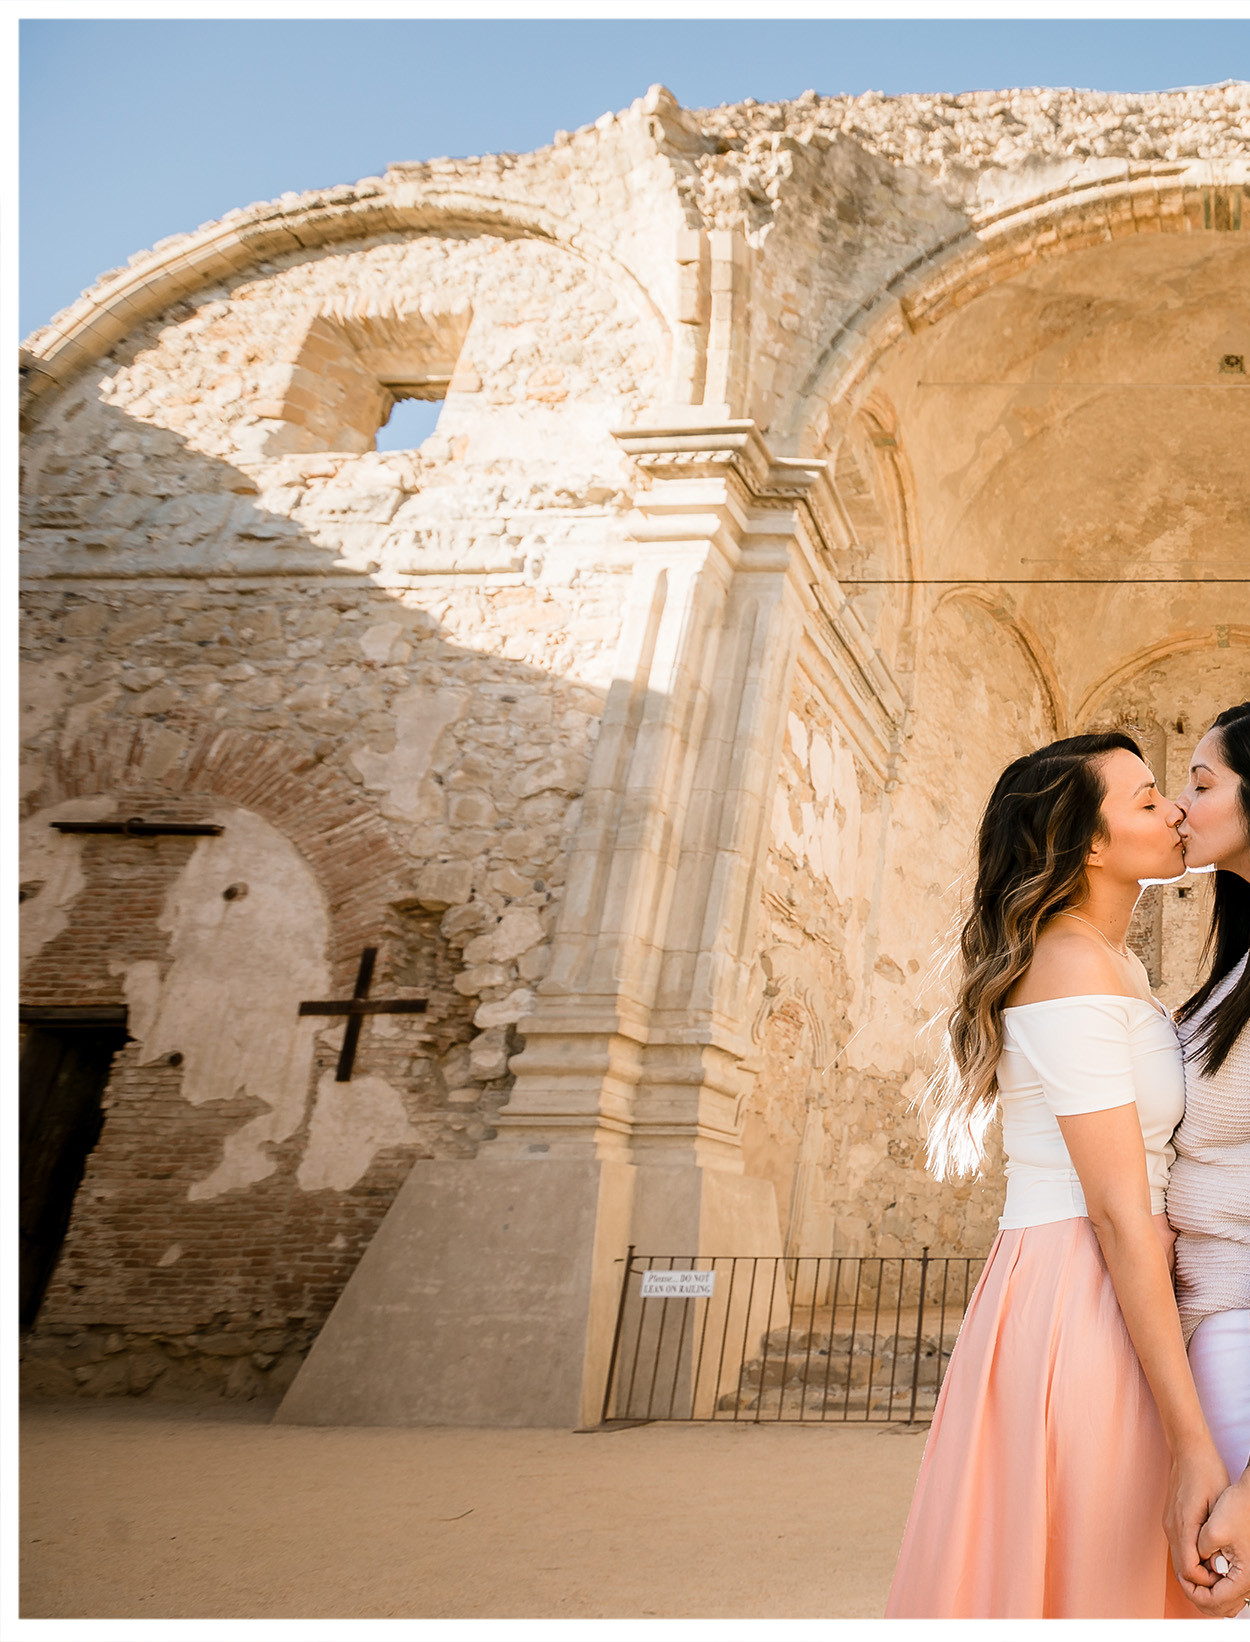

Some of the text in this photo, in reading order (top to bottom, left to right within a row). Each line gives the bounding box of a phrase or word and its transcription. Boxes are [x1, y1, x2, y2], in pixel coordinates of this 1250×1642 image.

[680, 1273, 691, 1282] DO
[693, 1273, 710, 1282] NOT
[643, 1284, 710, 1293] LEAN ON RAILING
